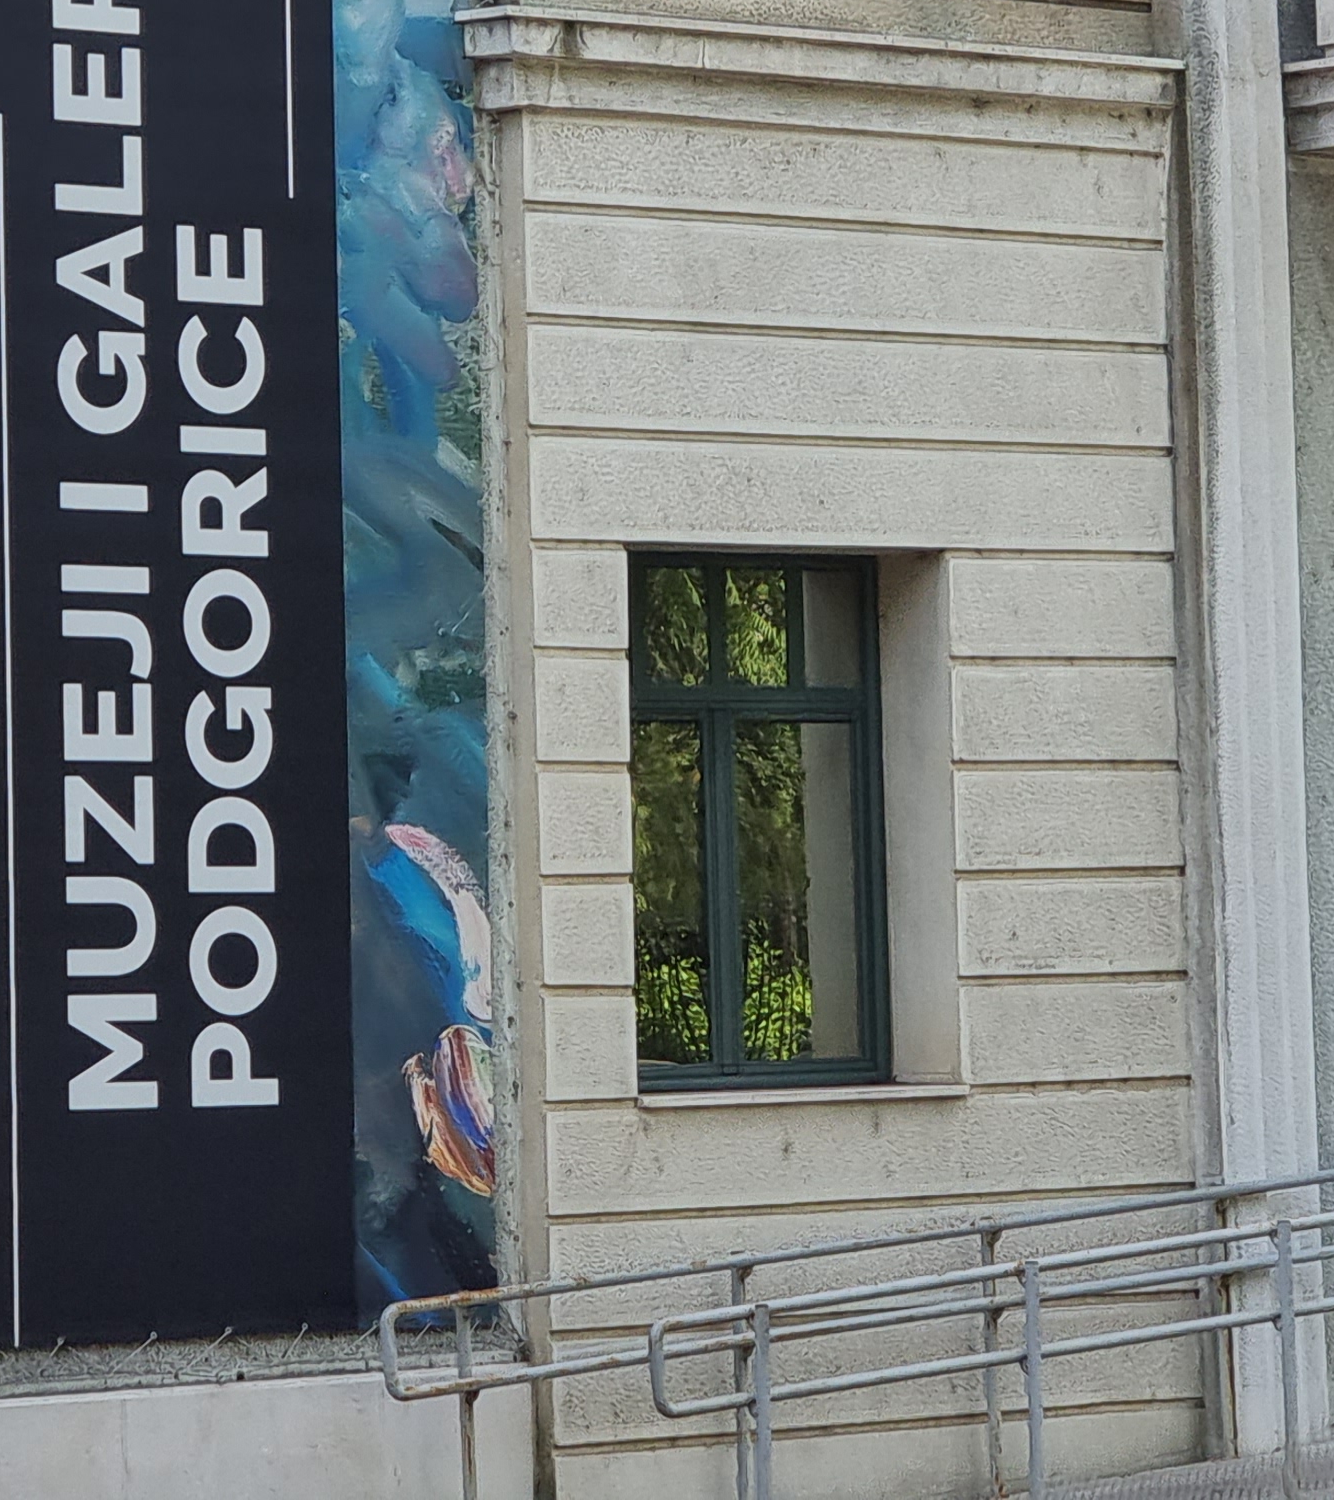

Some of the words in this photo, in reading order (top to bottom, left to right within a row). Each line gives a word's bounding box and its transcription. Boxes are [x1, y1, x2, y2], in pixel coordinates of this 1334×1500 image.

[60, 481, 149, 512] I
[176, 223, 280, 1108] PODGORICE
[60, 564, 159, 1111] MUZEJI
